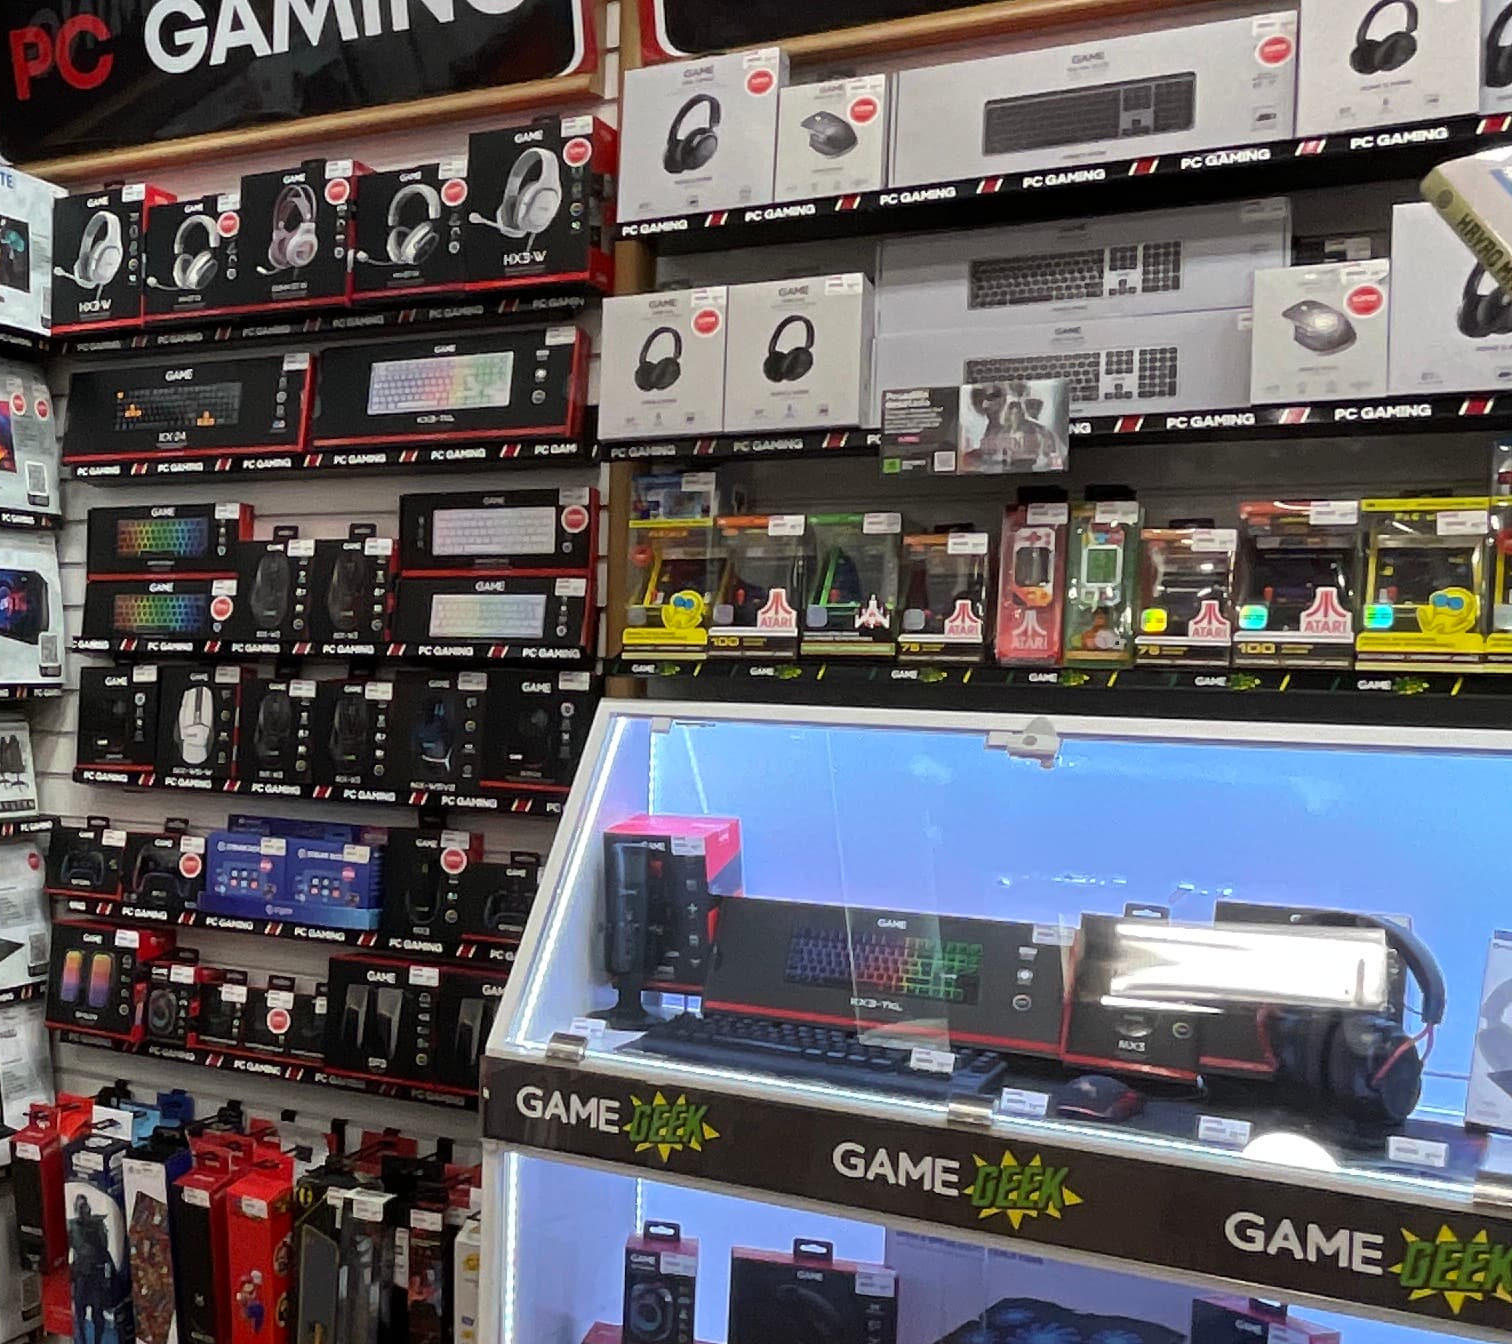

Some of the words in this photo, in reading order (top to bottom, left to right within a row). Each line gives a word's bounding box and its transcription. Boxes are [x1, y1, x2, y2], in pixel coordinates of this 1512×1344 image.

[10, 14, 114, 101] PC
[514, 130, 544, 144] GAME
[1350, 134, 1377, 151] PC
[1379, 126, 1448, 147] GAMING
[1180, 156, 1206, 171] PC
[1207, 147, 1271, 167] GAMING
[283, 173, 306, 184] GAME
[87, 196, 109, 208] GAME
[880, 192, 902, 206] PC
[904, 186, 956, 203] GAMING
[165, 369, 193, 381] GAME
[1334, 406, 1359, 421] PC
[1361, 402, 1431, 420] GAMING
[1166, 415, 1189, 430] PC
[1191, 411, 1255, 428] GAMING
[334, 456, 348, 465] PC
[349, 453, 386, 464] GAMING
[151, 507, 176, 517] GAME
[149, 582, 174, 593] GAME
[475, 581, 505, 592] GAME
[759, 615, 793, 629] ATARI
[1304, 619, 1348, 635] ATARI
[947, 624, 979, 636] ATARI
[1191, 626, 1228, 638] ATARI
[1011, 635, 1048, 650] ATARI
[1237, 642, 1276, 654] 100
[632, 664, 655, 674] GAME
[750, 665, 775, 677] GAME
[891, 669, 918, 681] GAME
[522, 682, 552, 693] GAME
[1194, 675, 1227, 688] GAME
[1358, 678, 1392, 691] GAME
[877, 918, 907, 930] GAME
[367, 970, 396, 984] GAME
[516, 1086, 620, 1135] GAME
[629, 1103, 710, 1145] GEEK
[832, 1142, 961, 1197] GAME
[973, 1164, 1070, 1209] GEEK
[1224, 1211, 1385, 1276] GAME
[1399, 1239, 1512, 1291] GEEK
